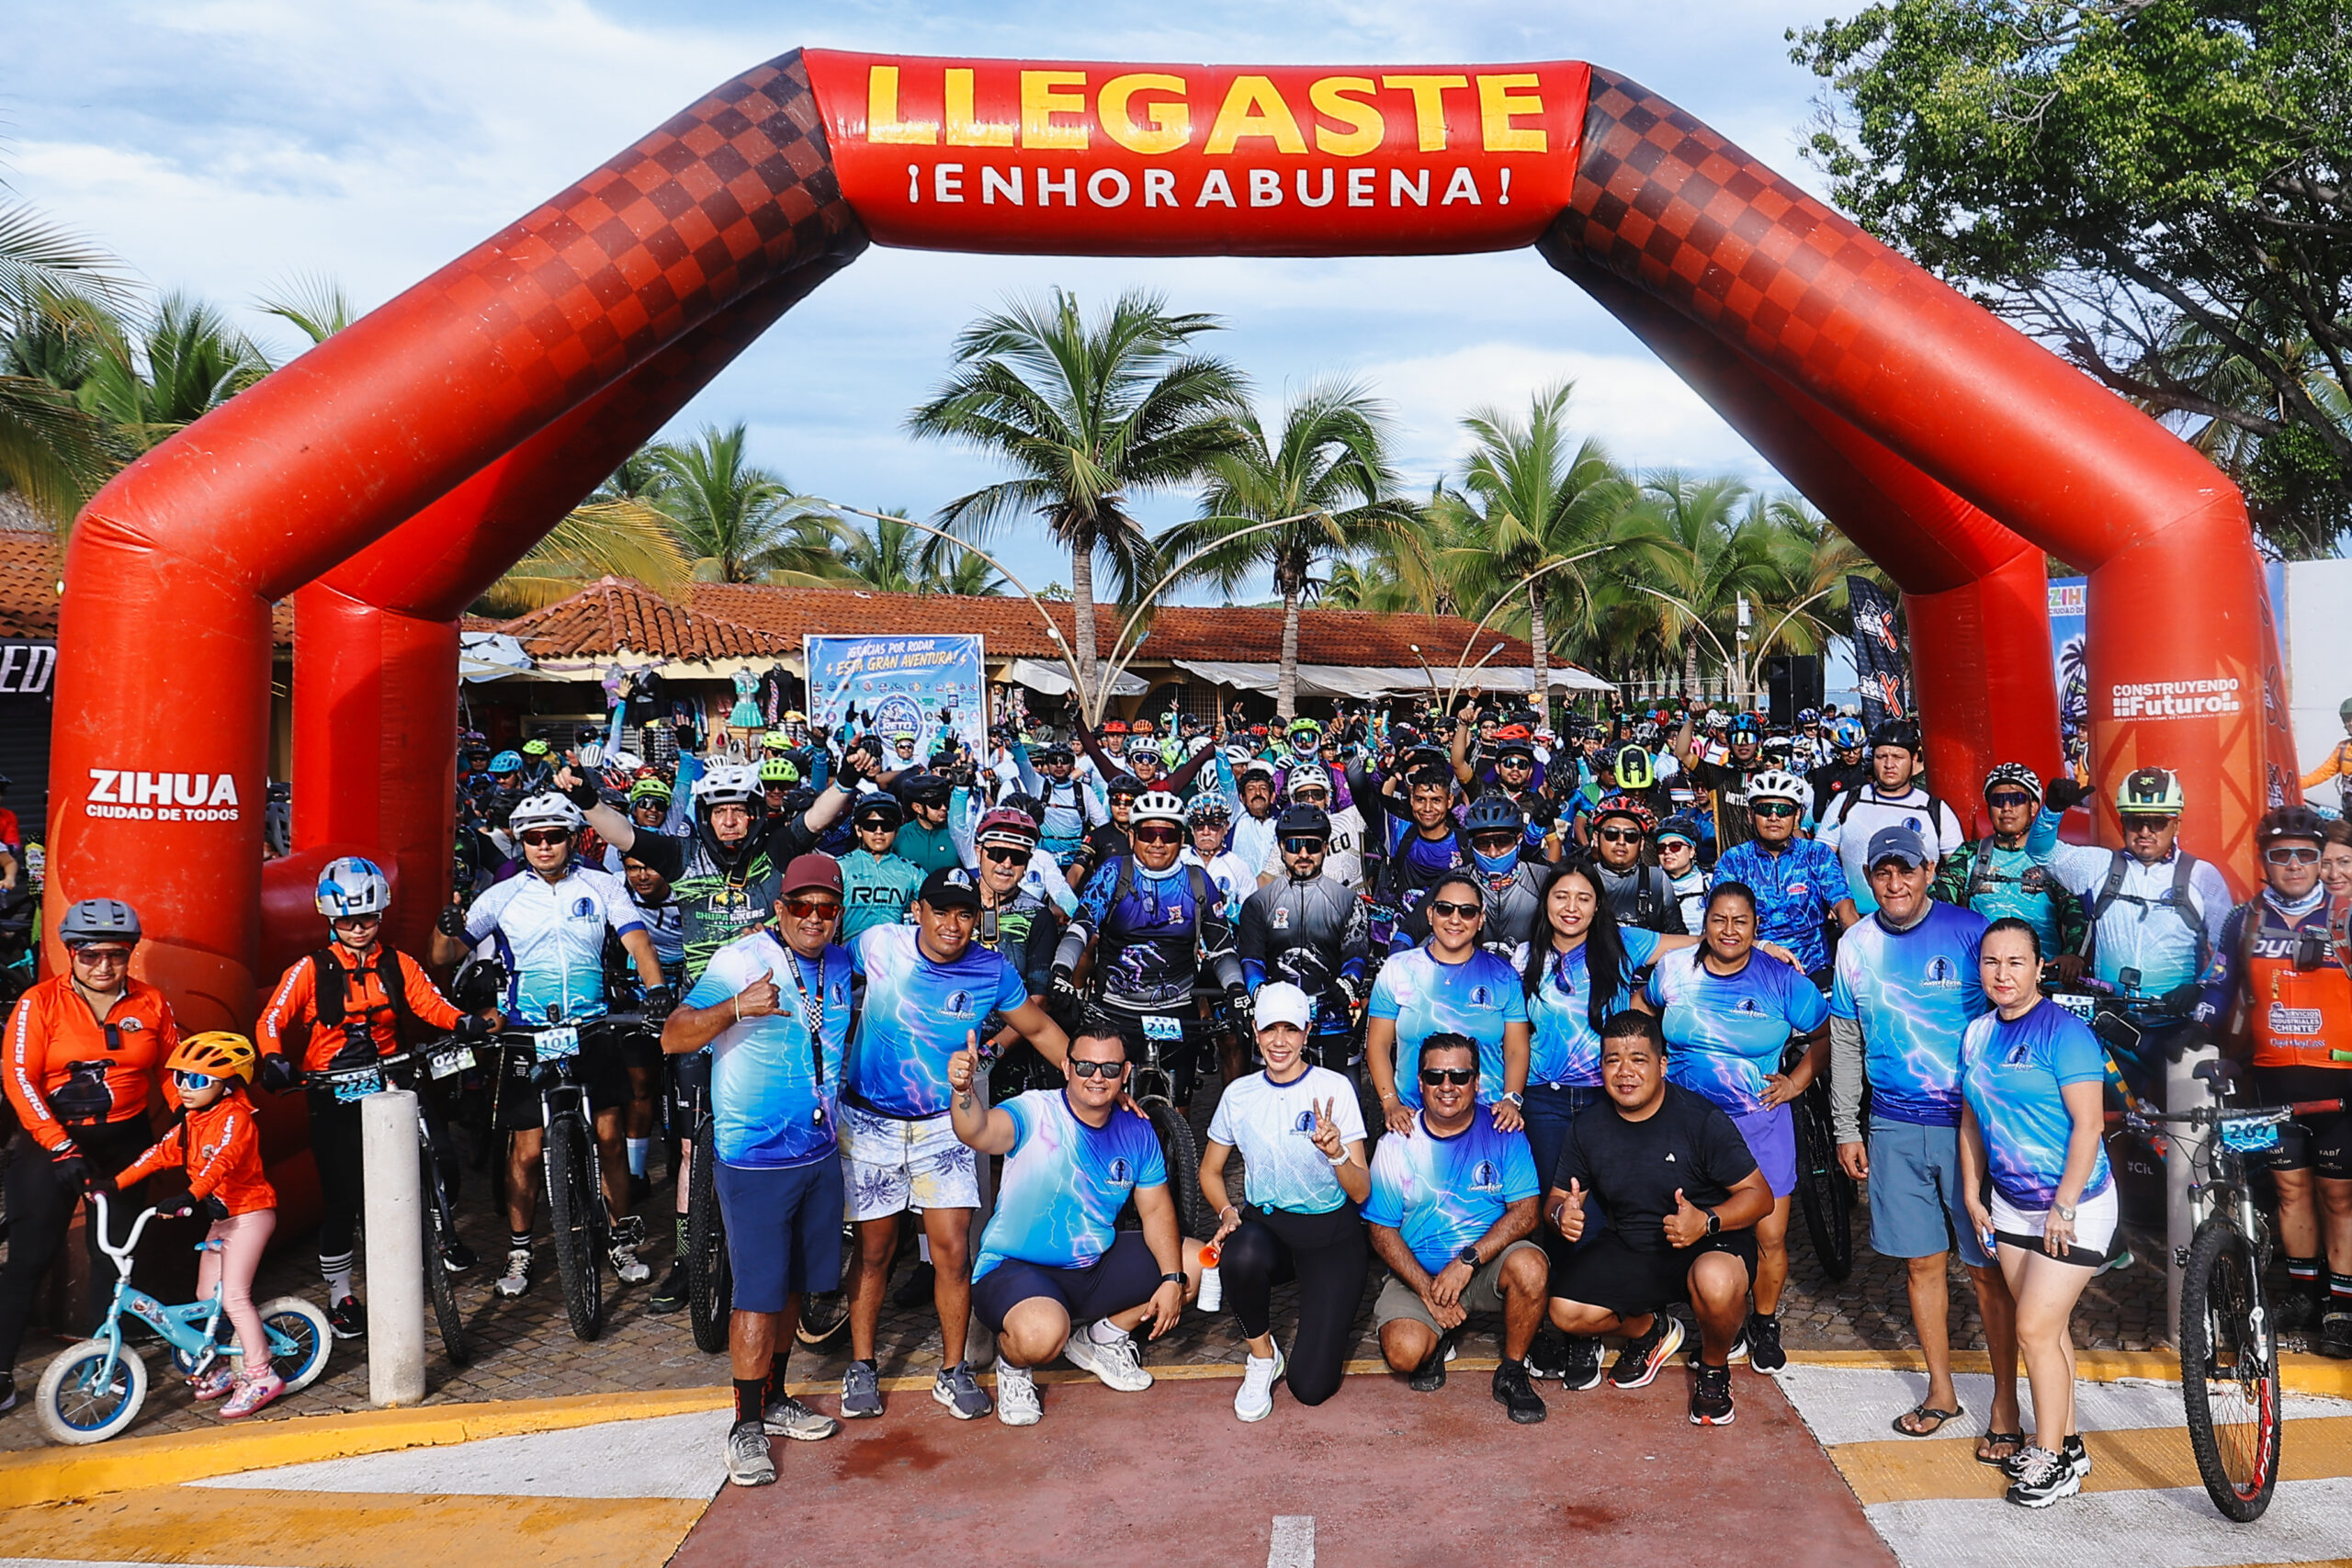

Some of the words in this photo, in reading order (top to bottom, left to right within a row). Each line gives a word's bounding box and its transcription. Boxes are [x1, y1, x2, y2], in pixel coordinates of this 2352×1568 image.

[866, 65, 1548, 157] LLEGASTE
[908, 163, 1511, 209] ¡ENHORABUENA!
[2050, 587, 2086, 606] ZIH
[2049, 606, 2075, 615] CIUDAD
[888, 641, 905, 654] POR
[907, 639, 935, 652] RODAR
[0, 645, 57, 693] ED
[835, 659, 863, 676] ESTA
[867, 655, 899, 671] GRAN
[900, 650, 960, 669] AVENTURA!
[2112, 678, 2239, 696] CONSTRUYENDO
[2130, 695, 2222, 716] Futuro
[881, 721, 912, 730] RETO
[87, 769, 239, 806] ZIHUA
[85, 804, 153, 820] CIUDAD
[157, 807, 181, 821] DE
[185, 808, 239, 821] TODOS
[15, 998, 31, 1065] PERROS
[1148, 1022, 1177, 1033] 214
[542, 1035, 571, 1050] 101
